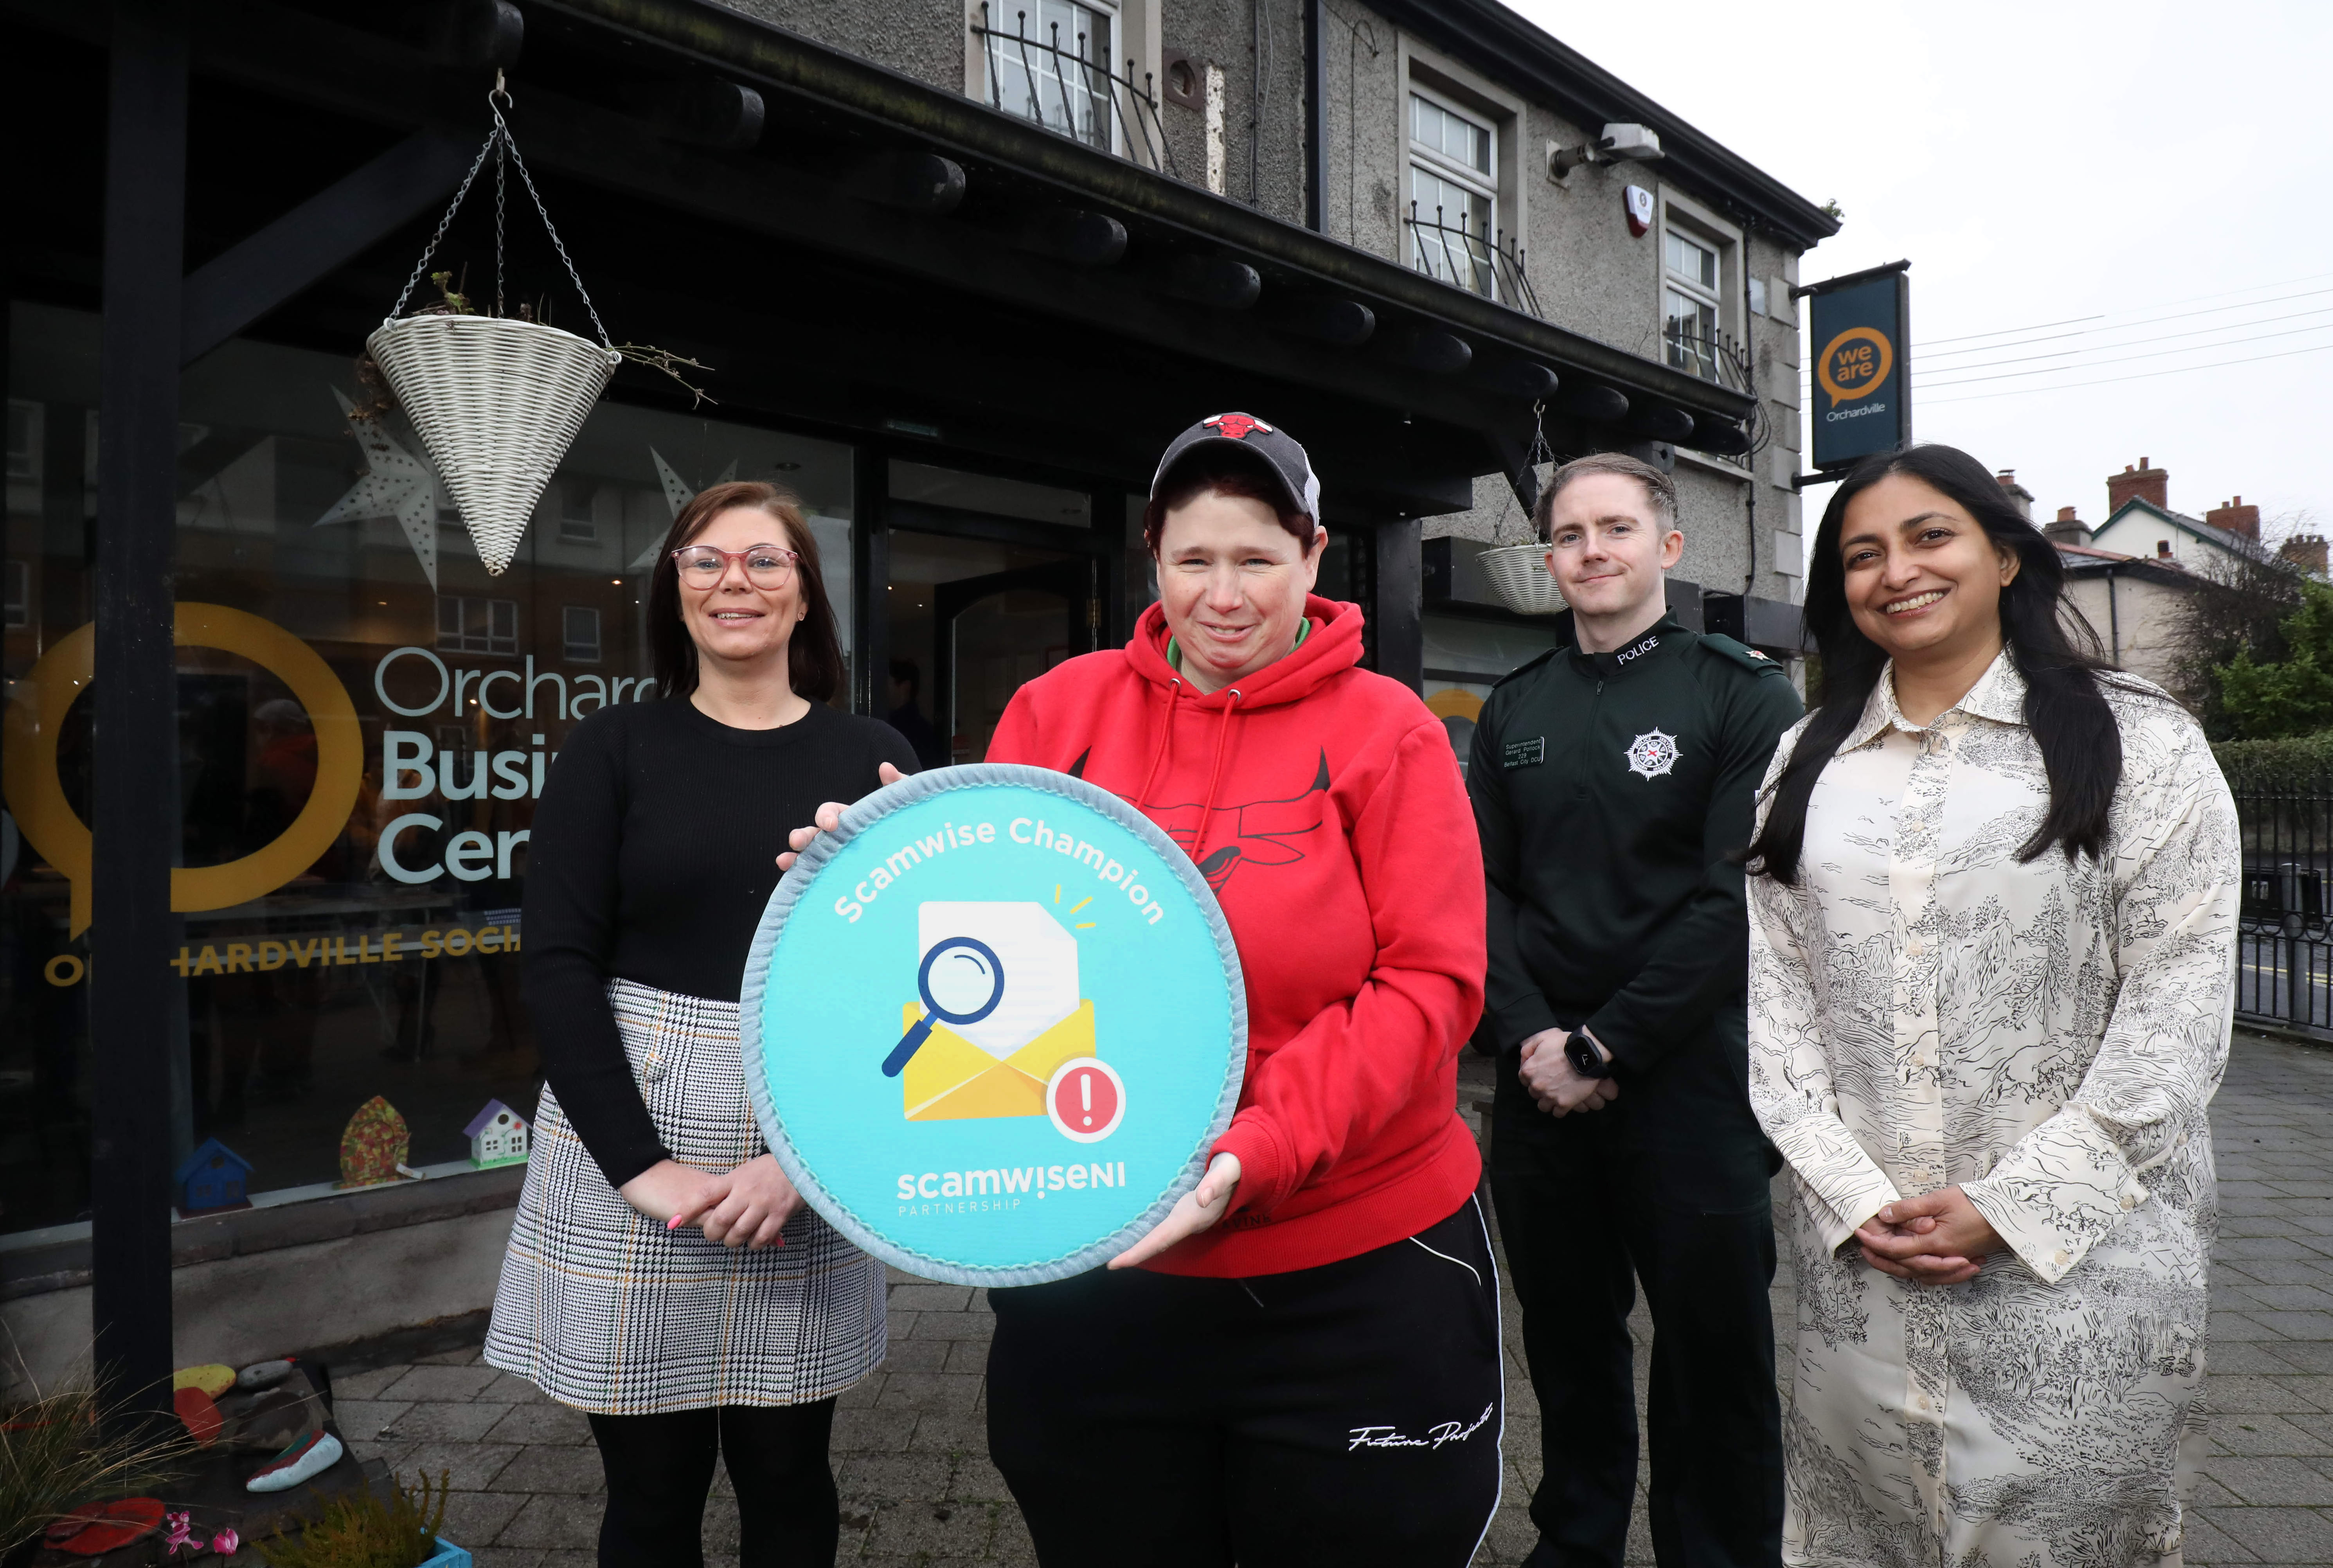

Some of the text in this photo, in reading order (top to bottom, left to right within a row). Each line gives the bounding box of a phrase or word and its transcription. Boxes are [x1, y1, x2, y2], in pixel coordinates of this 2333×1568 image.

[1838, 346, 1872, 365] we
[1837, 361, 1874, 382] are
[1826, 403, 1885, 422] Orchardville
[1617, 636, 1659, 665] POLICE
[374, 646, 656, 721] Orchar
[1506, 739, 1541, 750] Superintendent
[1635, 736, 1673, 753] POLICE SERVICE
[383, 731, 557, 800] Busi
[1653, 758, 1670, 771] IRELAND
[834, 817, 1164, 926] Scamwise Champion
[420, 926, 521, 959] SOCI
[899, 1198, 1021, 1217] PARTNERSHIP
